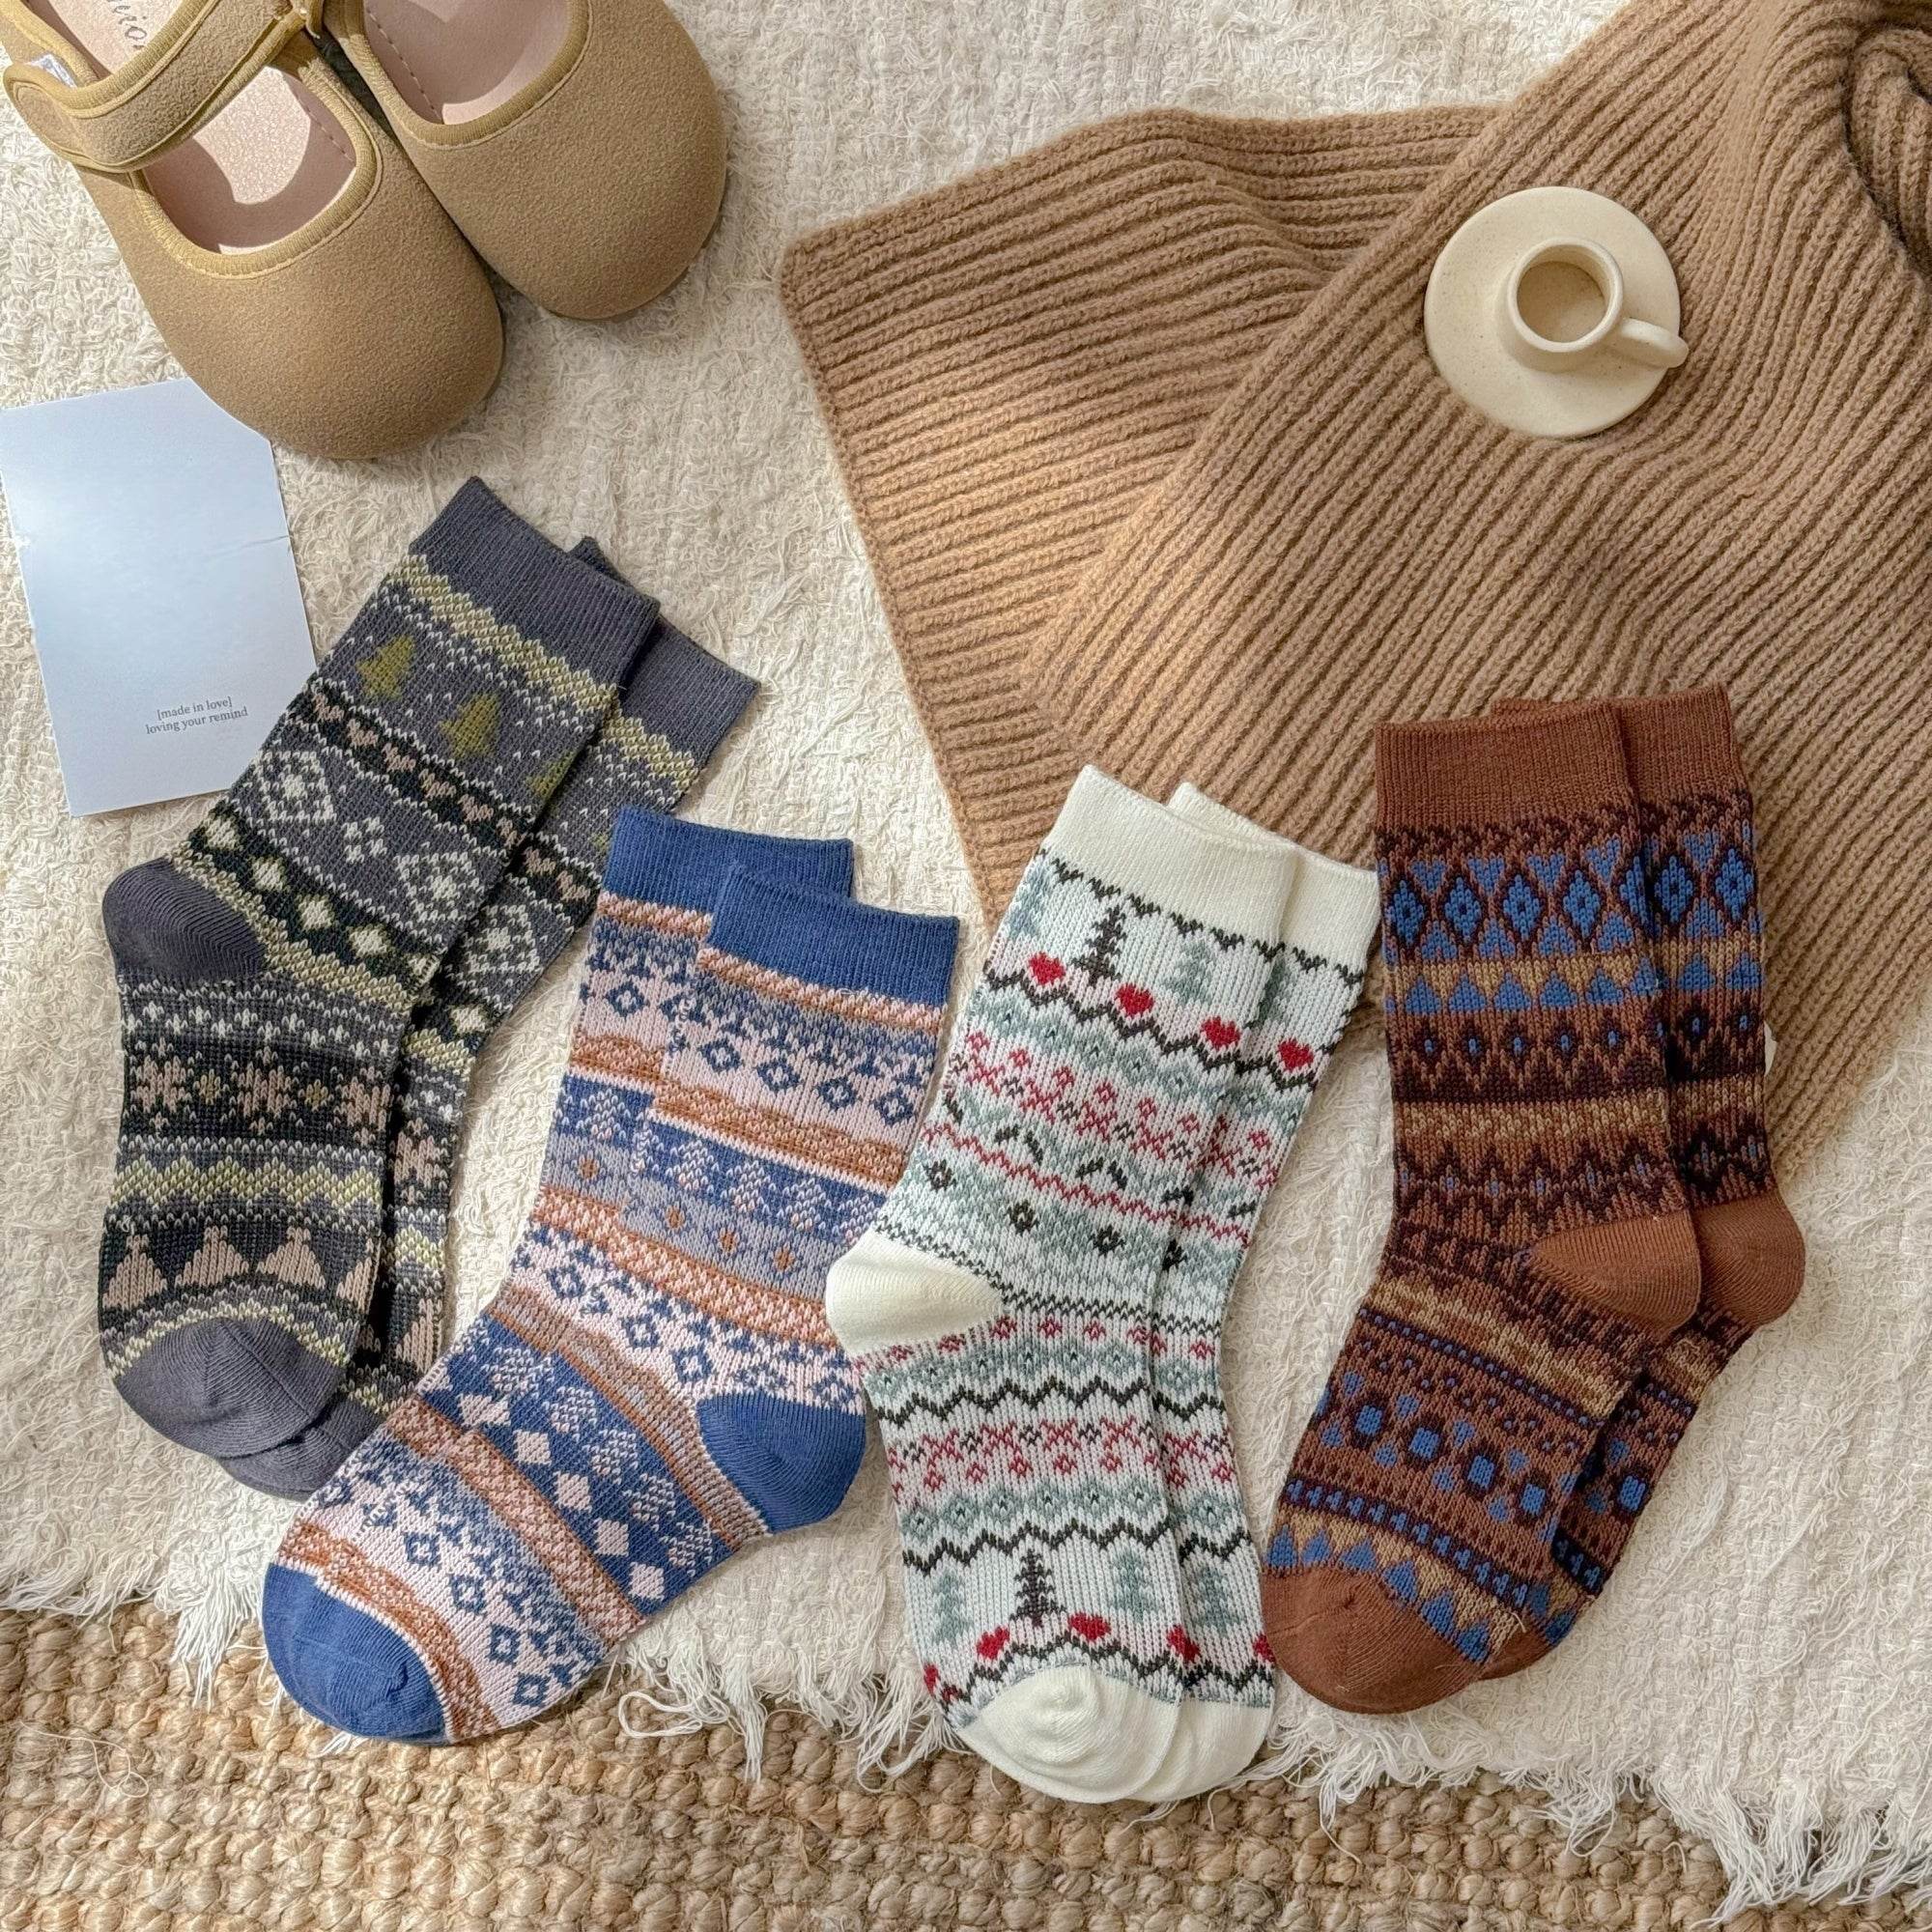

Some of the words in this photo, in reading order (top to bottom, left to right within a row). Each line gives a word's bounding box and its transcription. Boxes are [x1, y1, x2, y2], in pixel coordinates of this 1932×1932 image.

[145, 722, 181, 734] loving
[181, 717, 206, 731] your
[209, 705, 248, 723] remind
[156, 705, 190, 721] [made
[193, 702, 204, 713] in
[206, 696, 233, 710] love]
